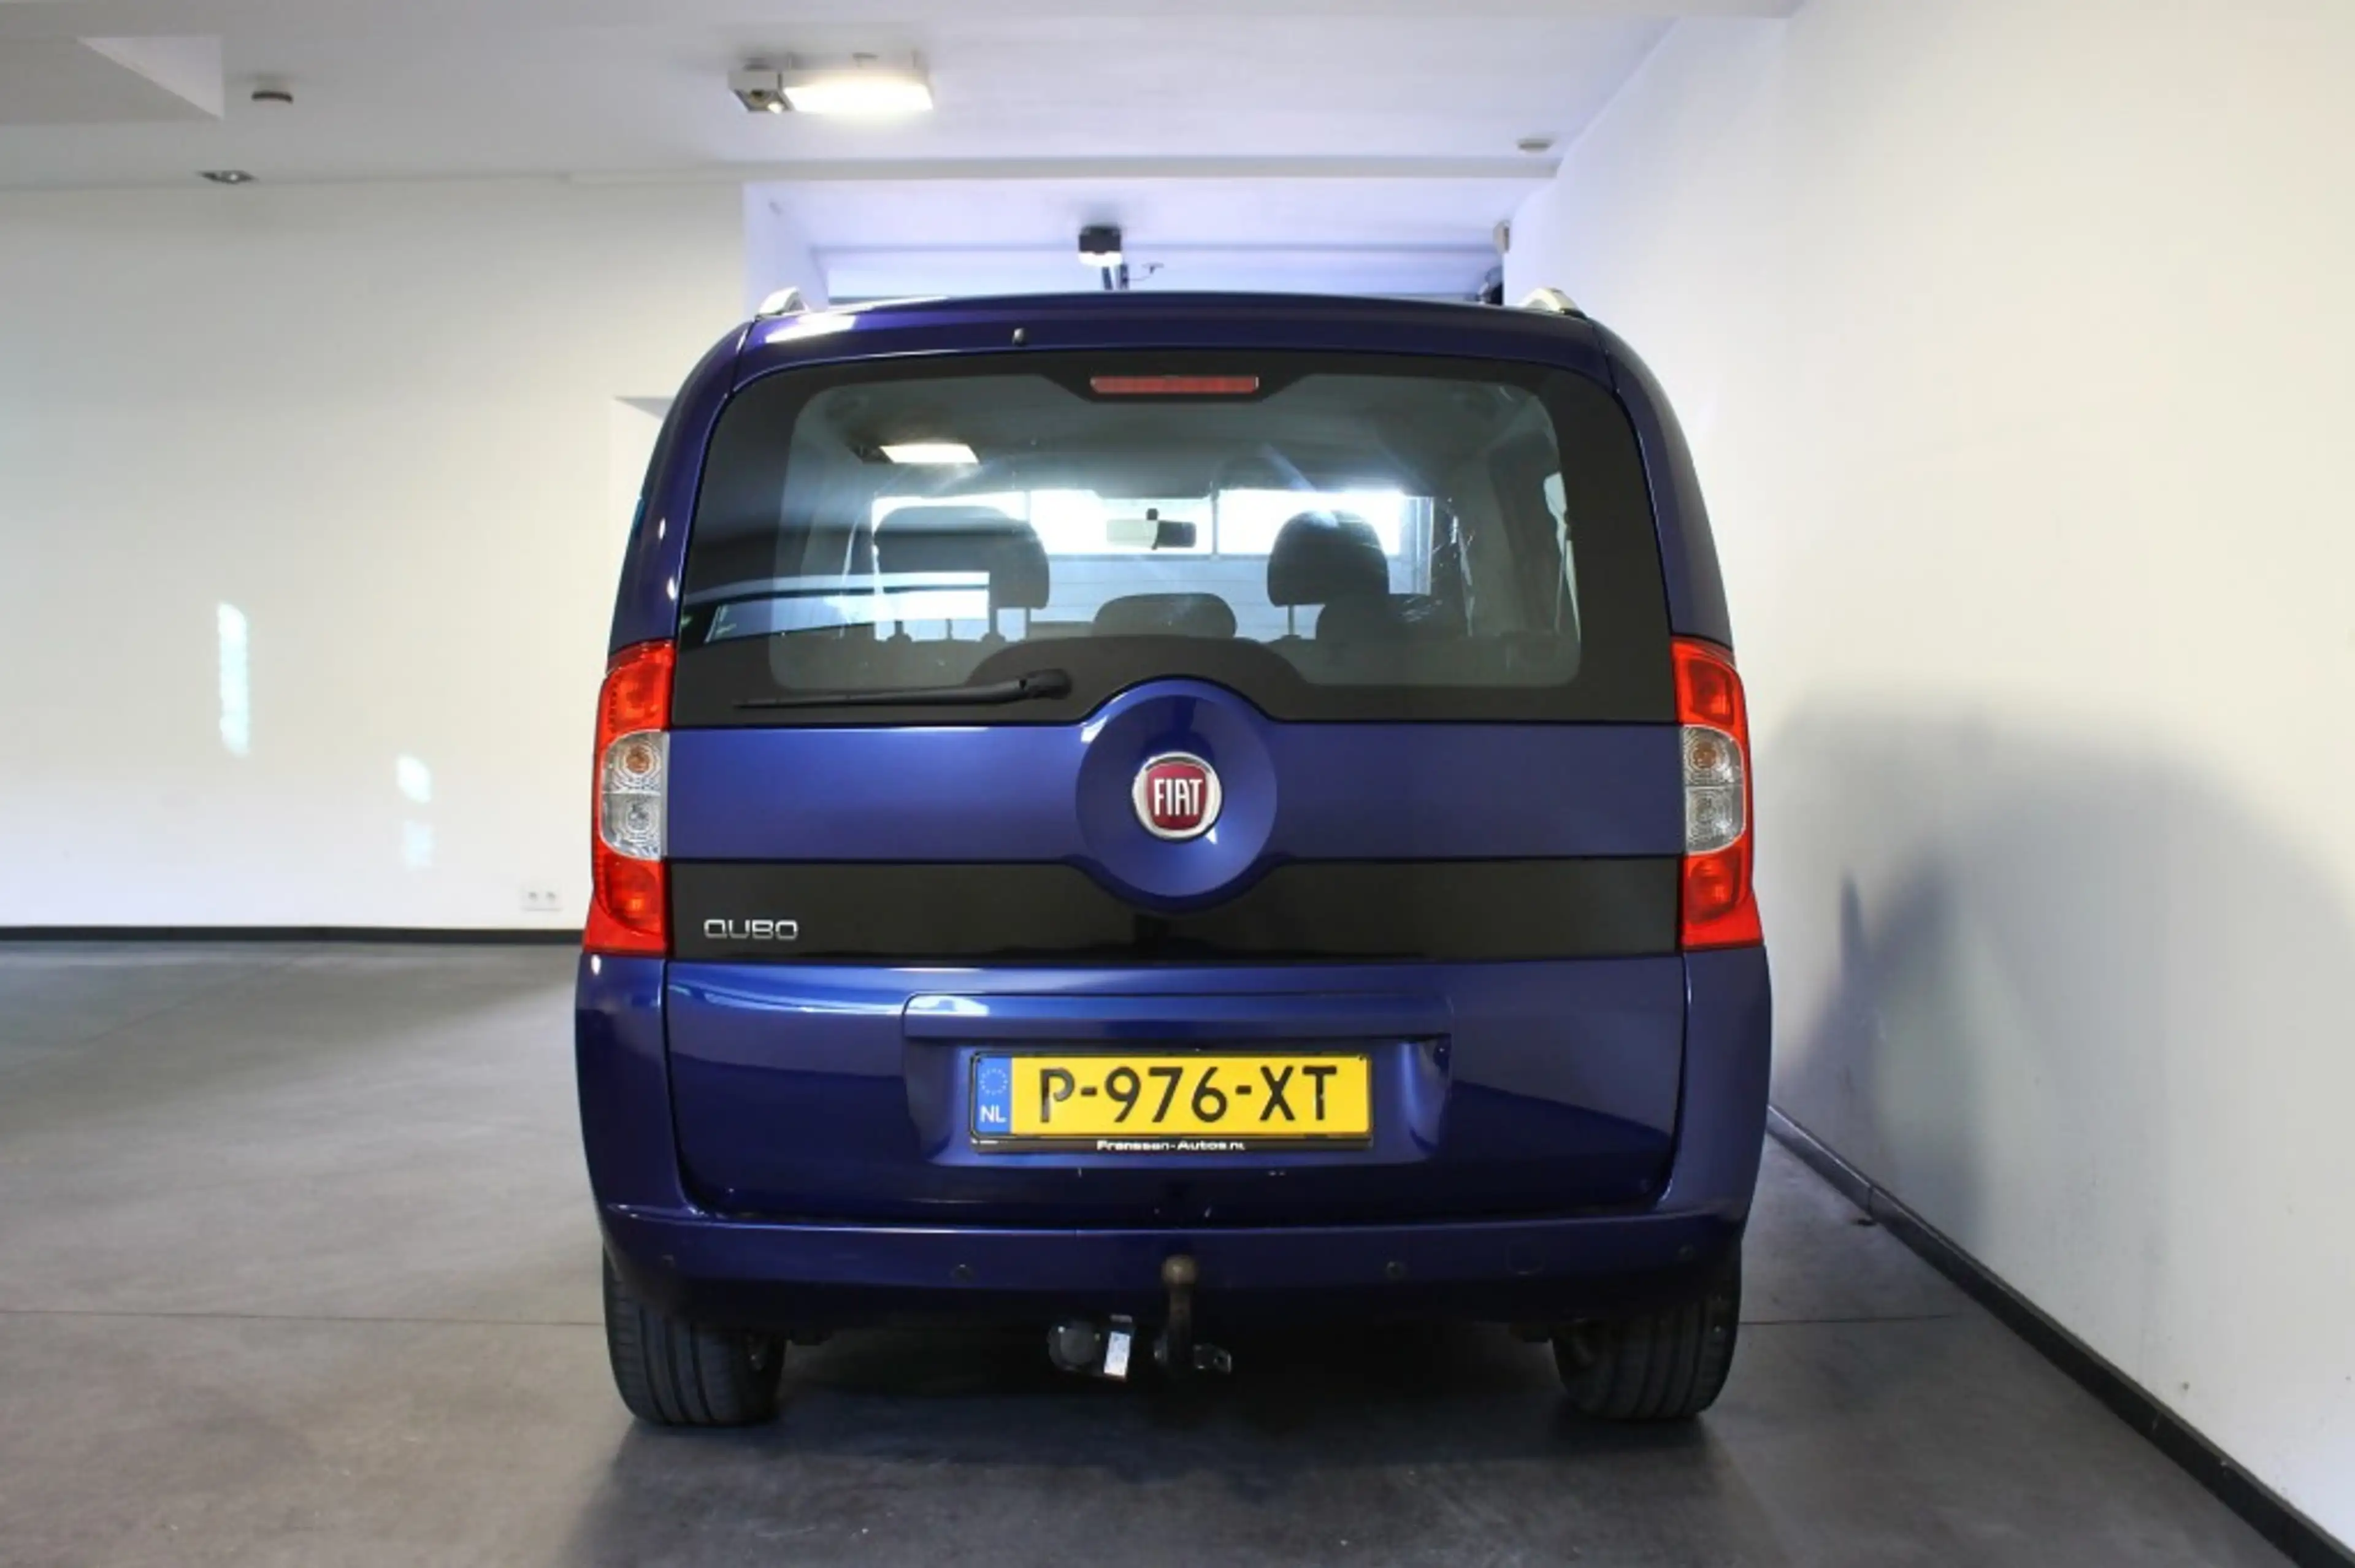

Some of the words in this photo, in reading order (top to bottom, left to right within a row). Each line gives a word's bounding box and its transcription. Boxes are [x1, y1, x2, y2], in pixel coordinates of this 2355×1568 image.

[1154, 778, 1203, 817] FIAT
[704, 919, 798, 940] QUBO
[1040, 1066, 1338, 1123] P-976-XT
[981, 1104, 1006, 1123] NL
